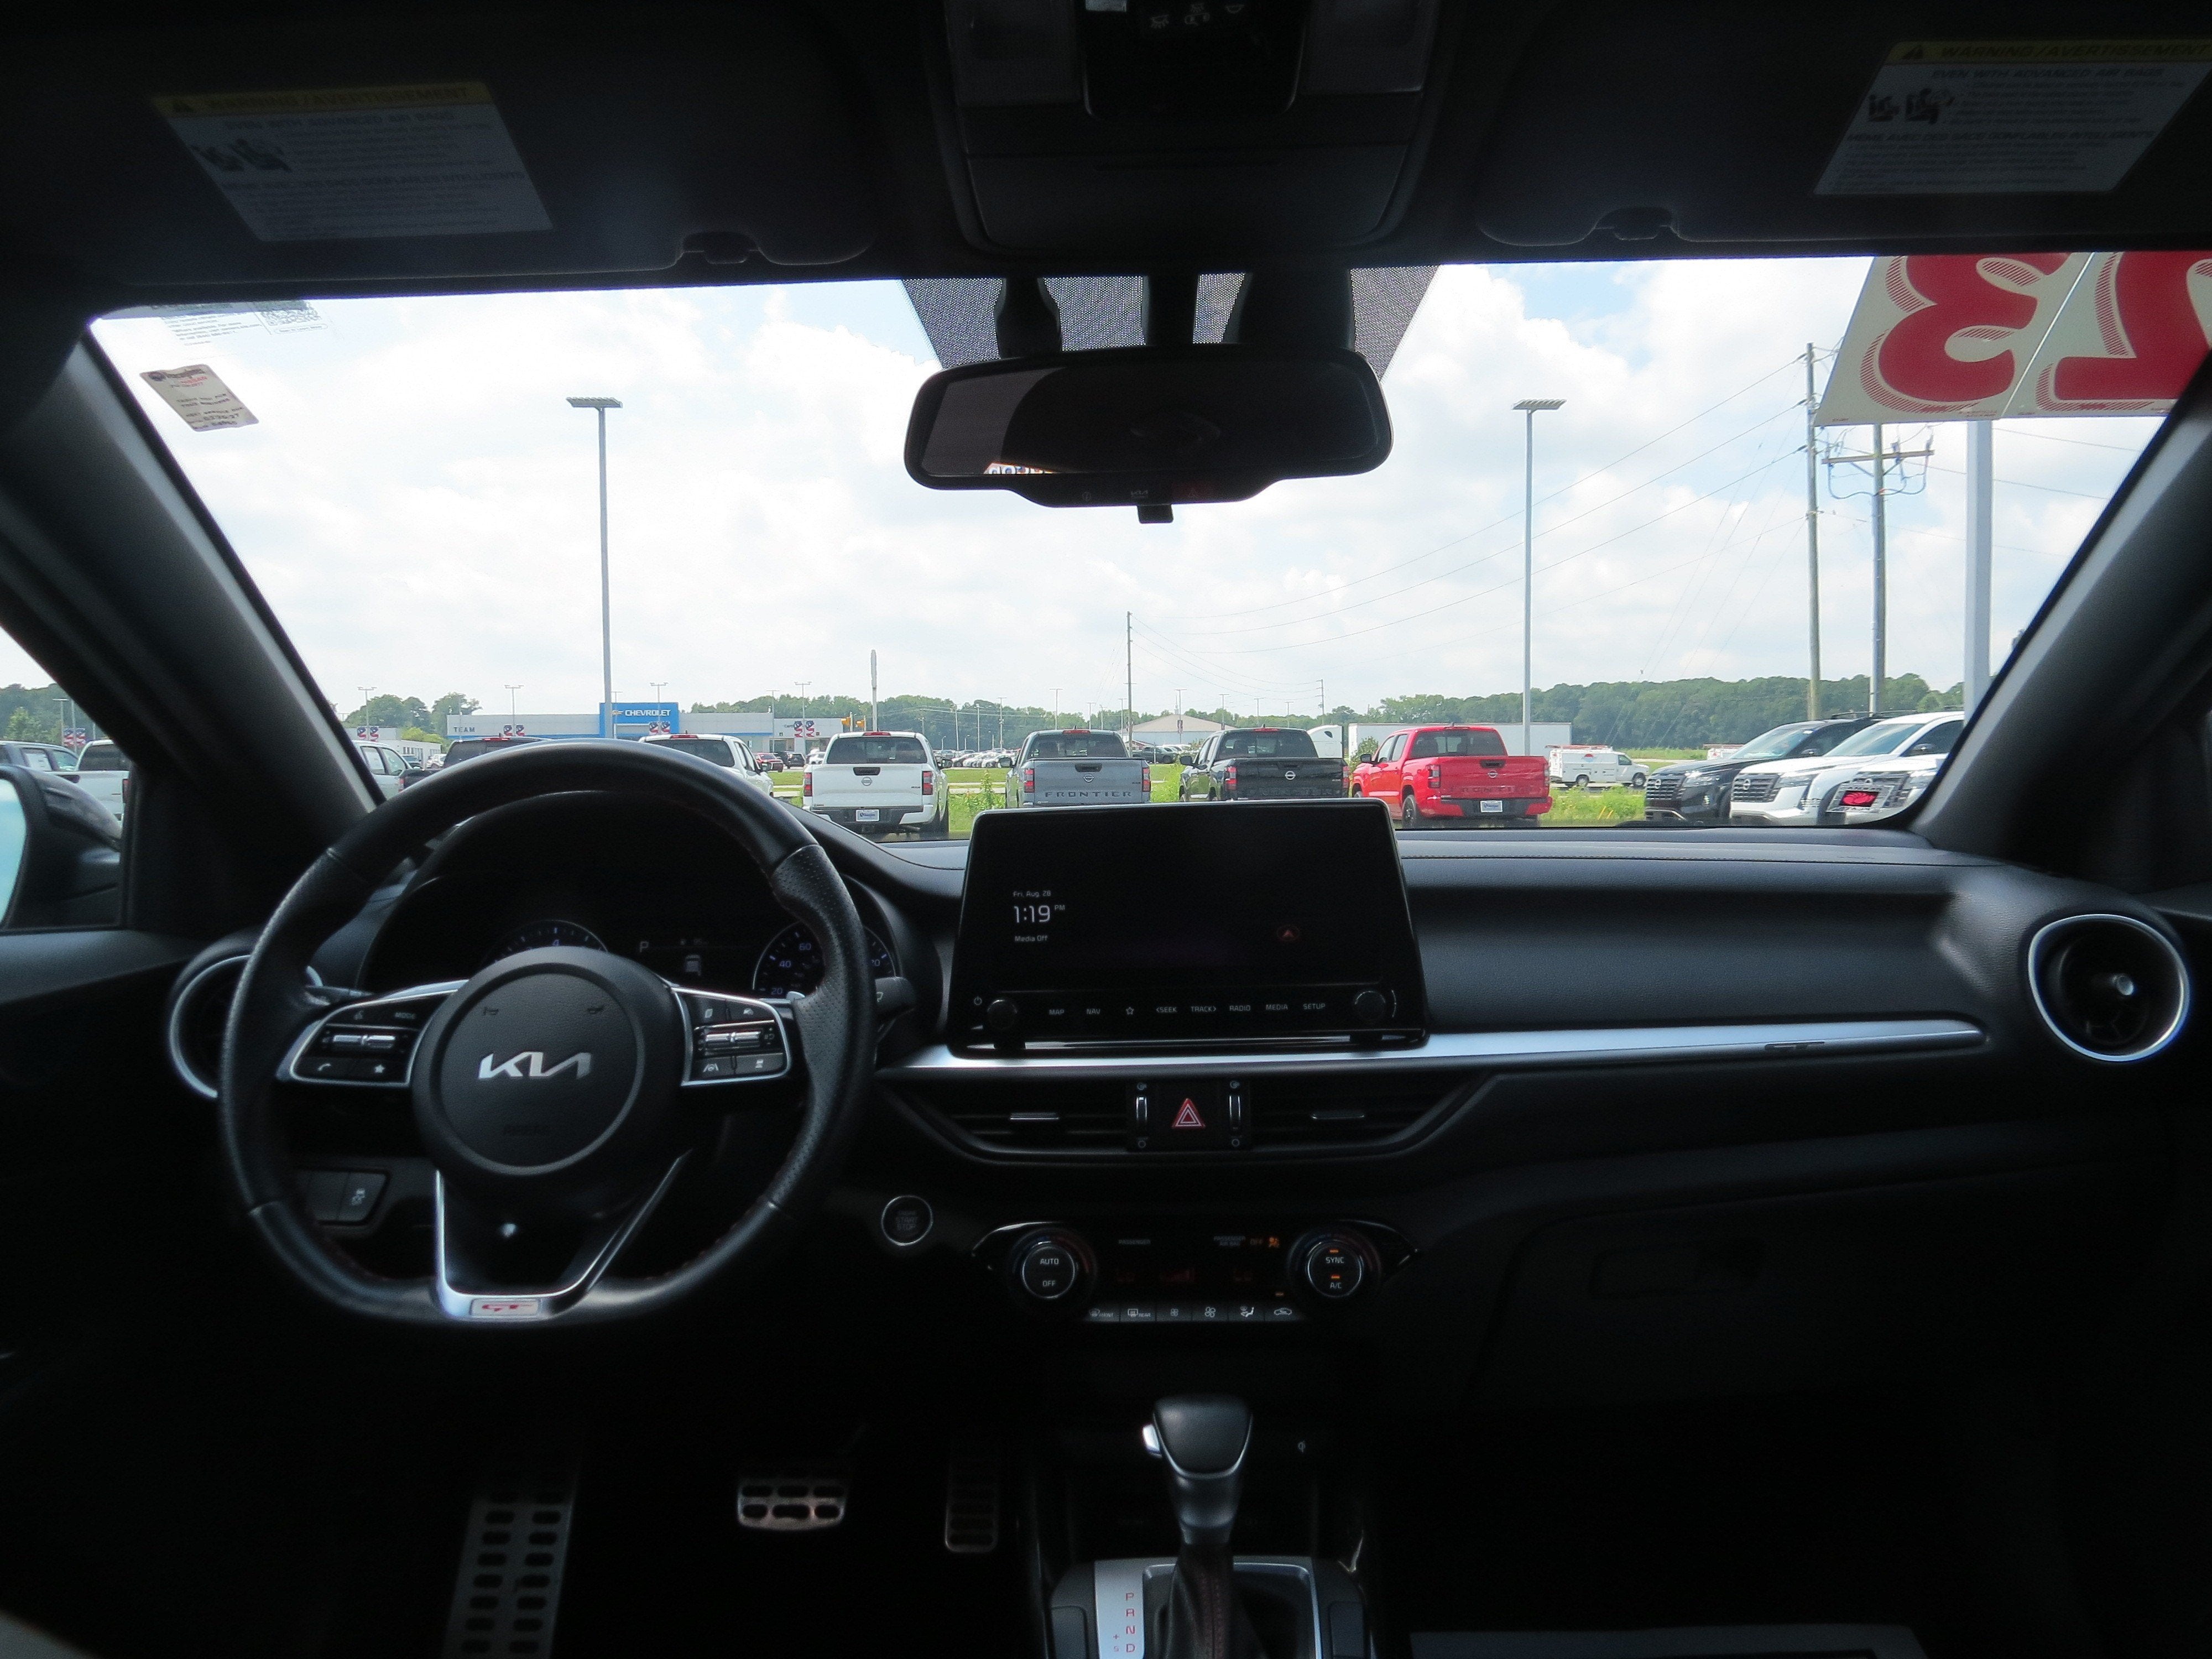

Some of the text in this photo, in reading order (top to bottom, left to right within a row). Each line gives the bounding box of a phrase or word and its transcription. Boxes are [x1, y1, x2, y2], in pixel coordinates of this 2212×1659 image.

[1013, 905, 1051, 923] 1:19
[640, 941, 650, 952] P
[778, 960, 792, 968] 40
[1125, 1592, 1135, 1601] P
[1125, 1608, 1135, 1617] R
[1125, 1625, 1136, 1635] N
[1126, 1643, 1136, 1653] D
